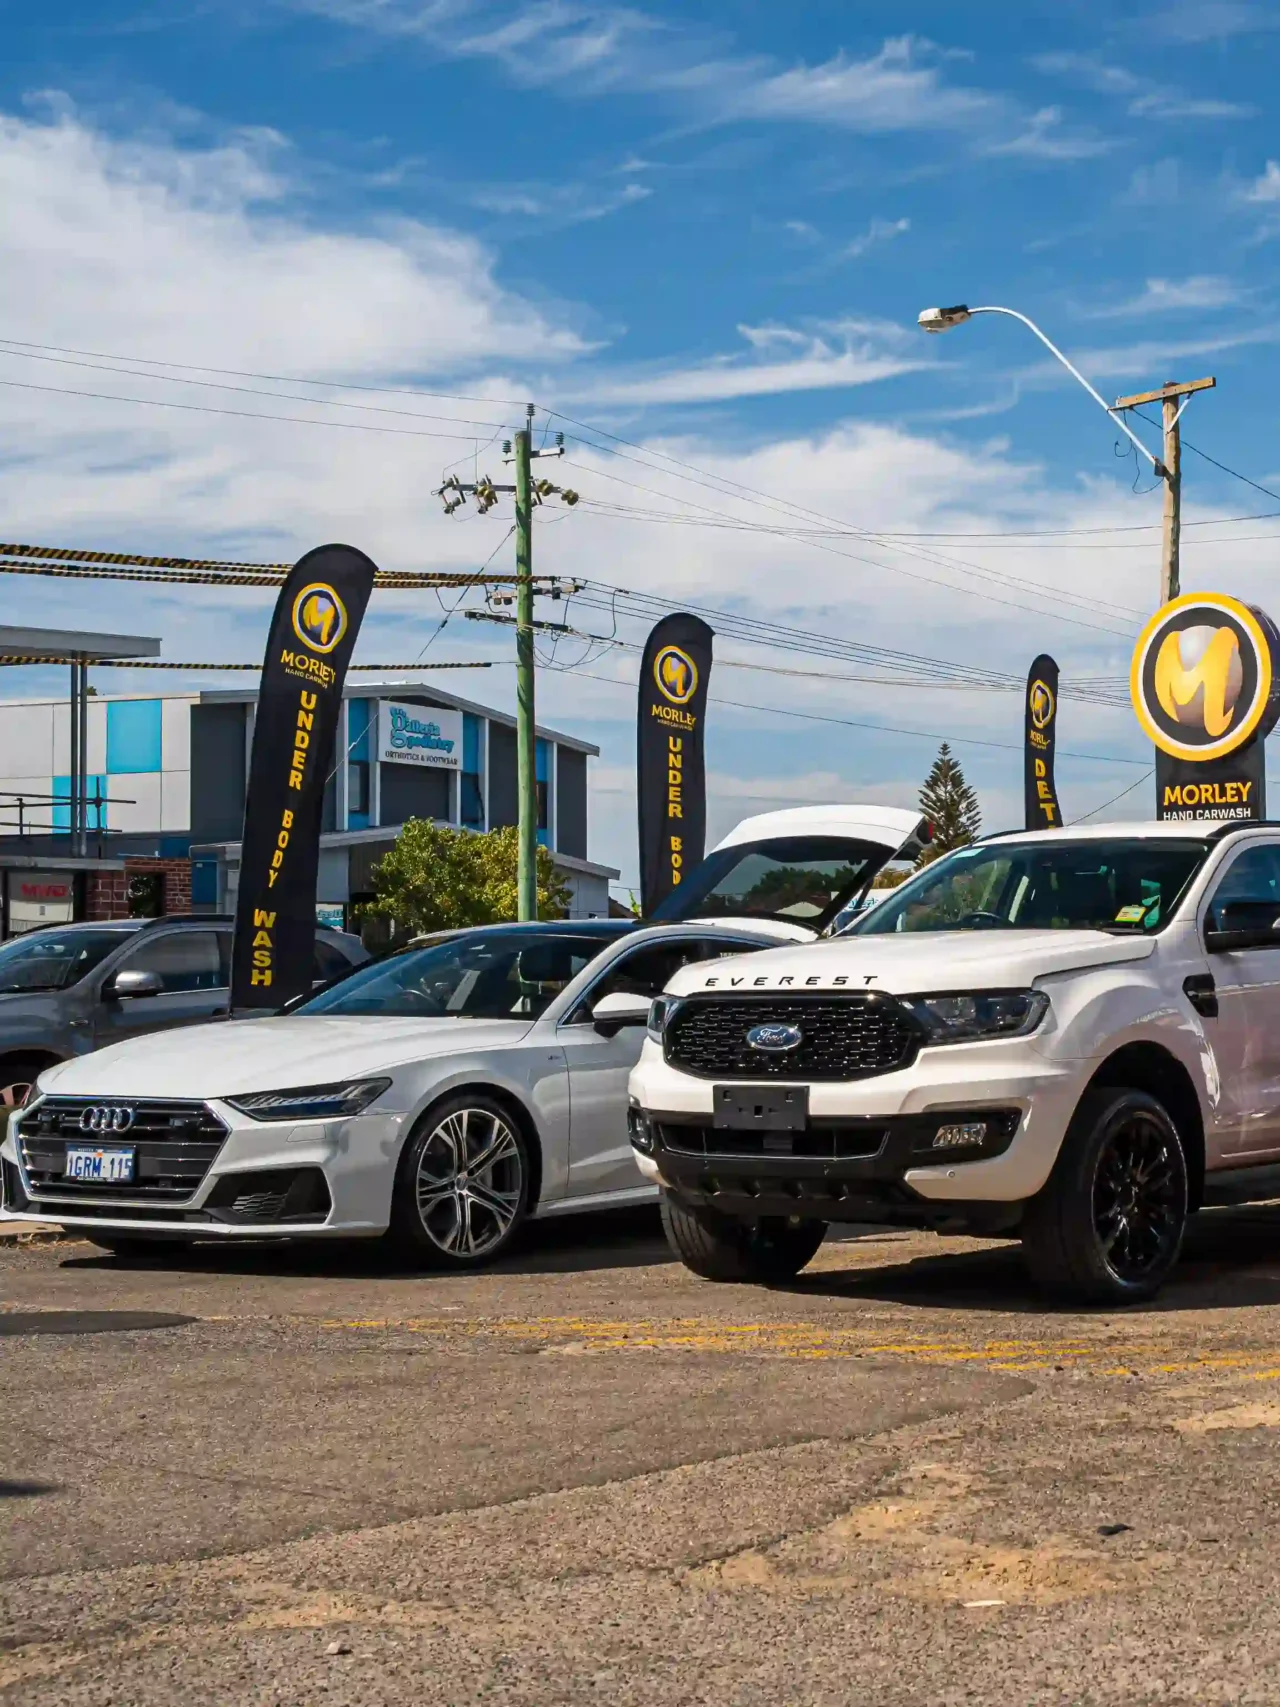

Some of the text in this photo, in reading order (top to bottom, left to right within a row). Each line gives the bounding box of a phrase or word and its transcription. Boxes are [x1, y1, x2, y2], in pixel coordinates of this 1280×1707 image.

[285, 667, 304, 677] HAND
[668, 735, 683, 818] UNDER
[1035, 758, 1056, 829] DET
[1163, 781, 1252, 806] MORLEY
[1163, 807, 1251, 821] HAND CARWASH
[251, 690, 316, 986] UNDER BODY WASH
[705, 976, 878, 987] EVEREST
